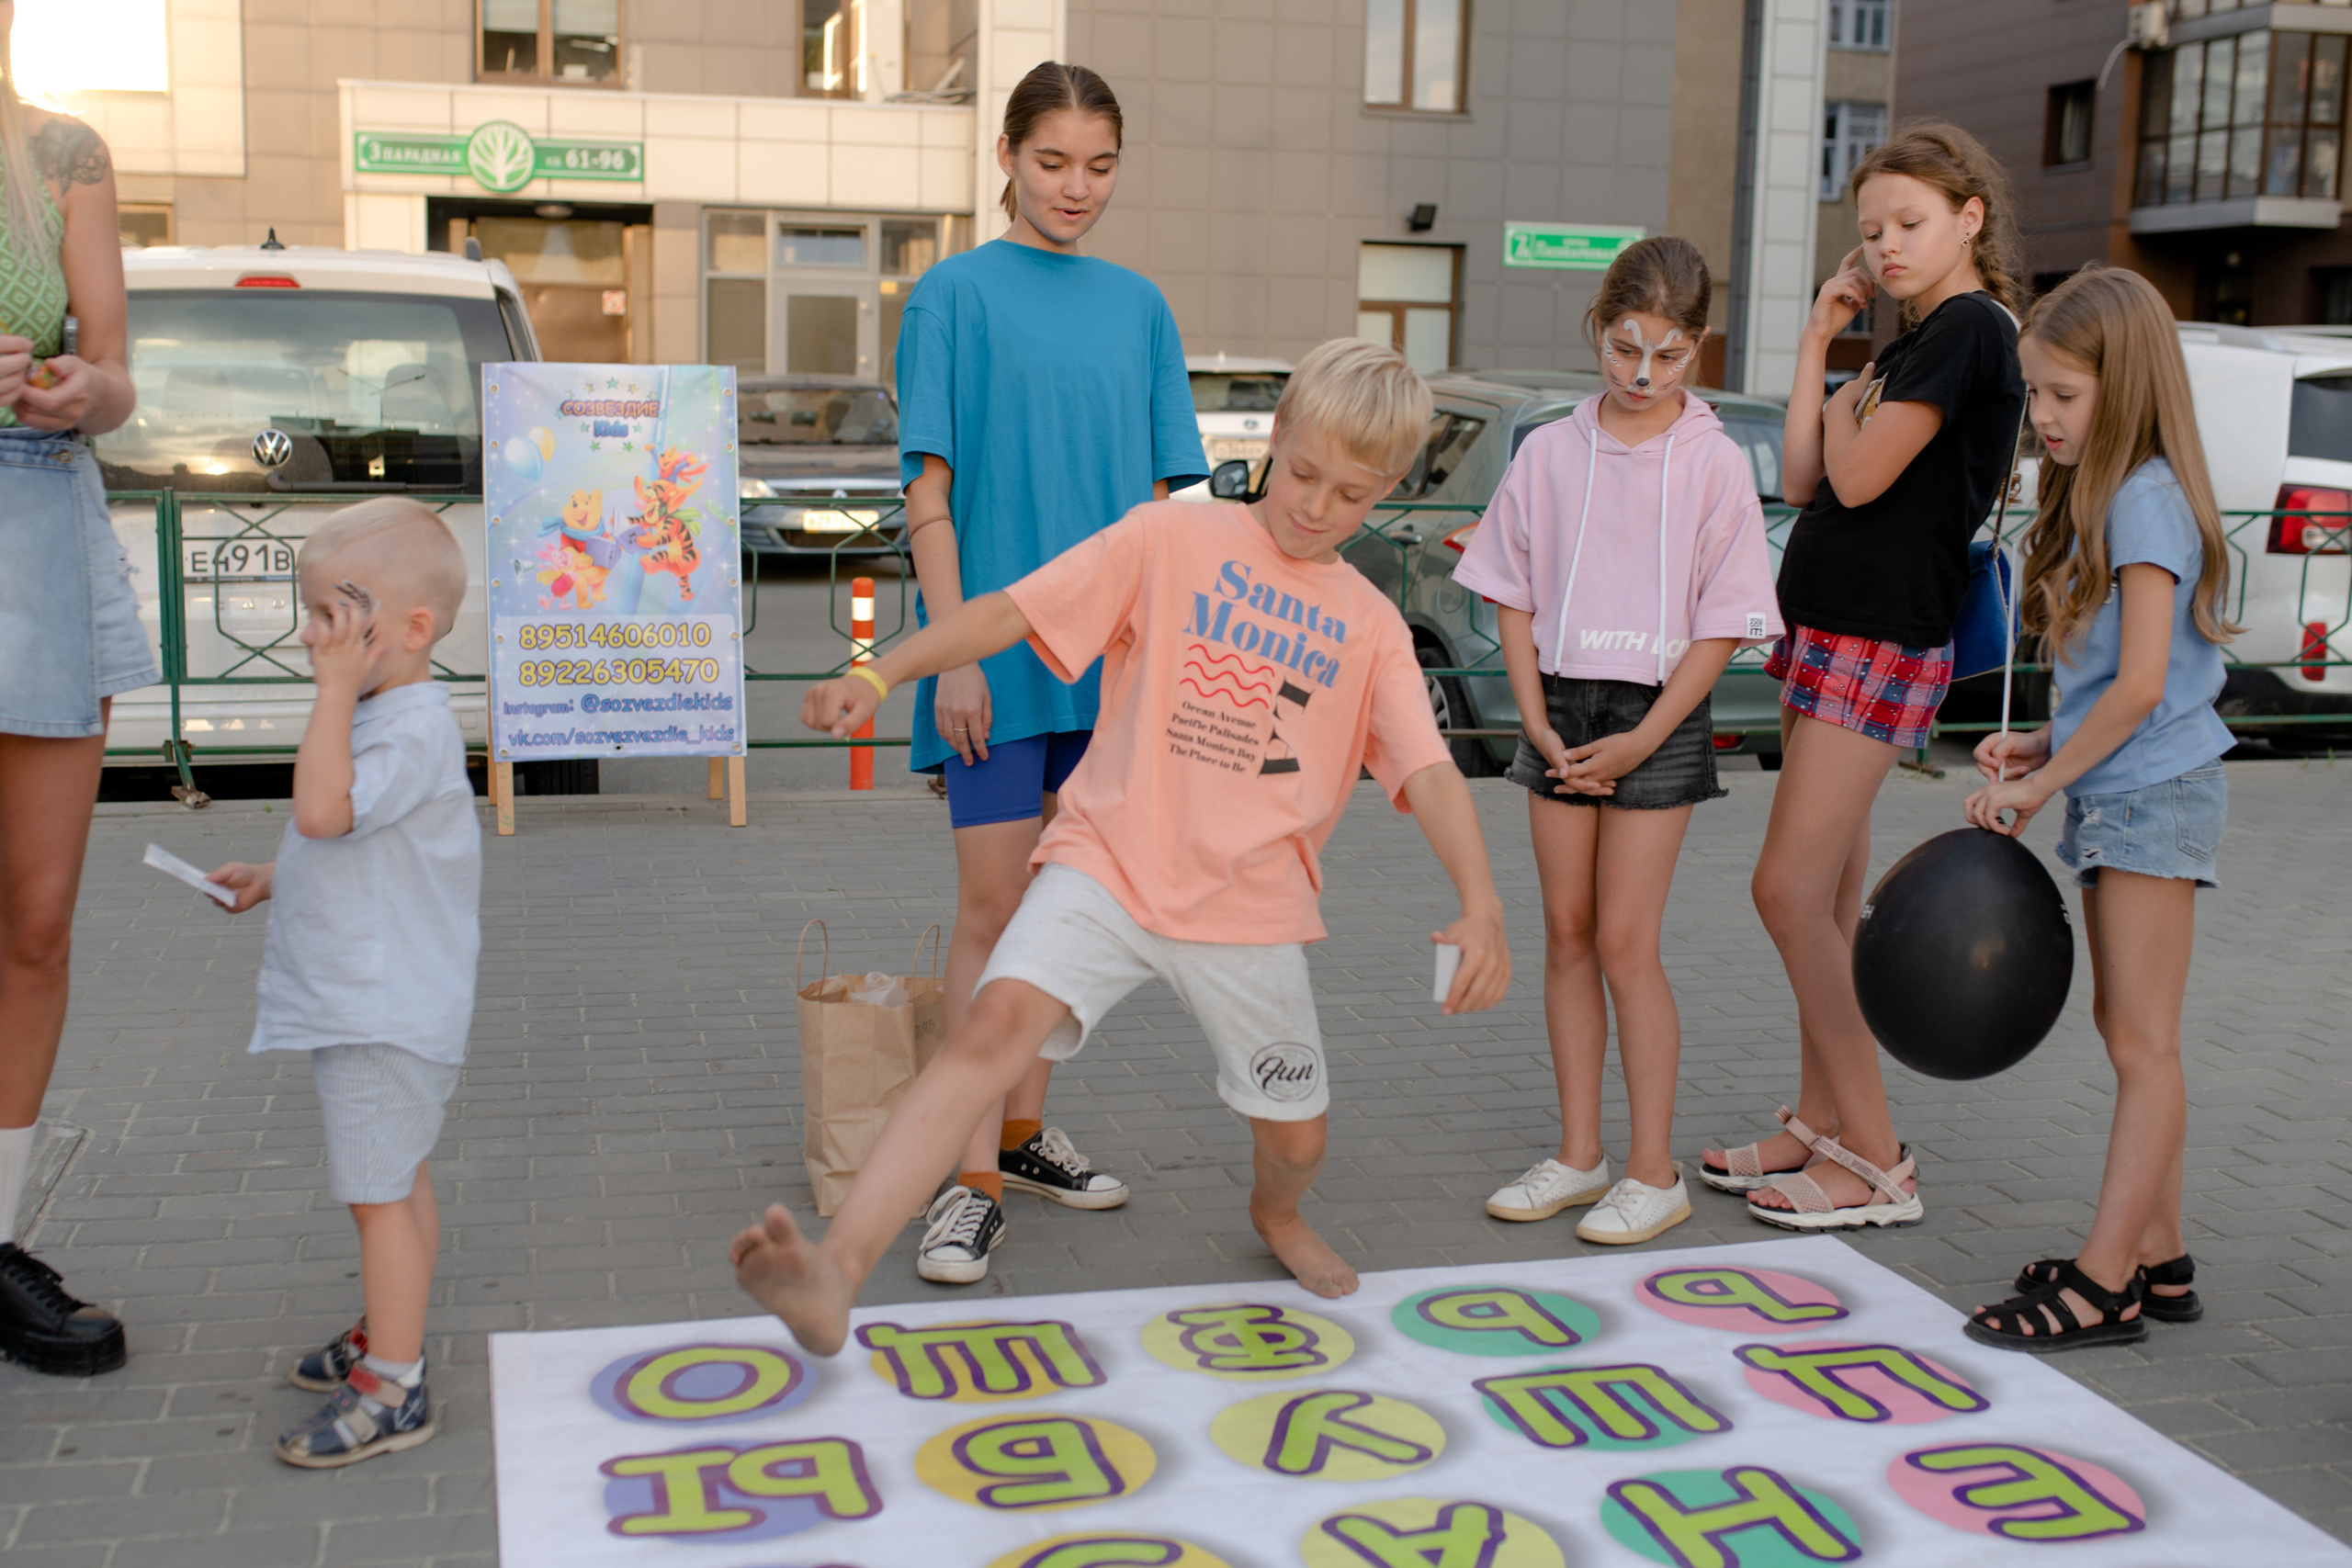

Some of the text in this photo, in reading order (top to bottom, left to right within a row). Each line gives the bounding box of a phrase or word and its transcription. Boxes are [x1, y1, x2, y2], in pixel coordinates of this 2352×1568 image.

[368, 141, 381, 162] 3
[383, 147, 460, 164] ПАРАДНАЯ
[565, 148, 626, 171] 61-96
[560, 400, 661, 419] СОЗВЕЗДИЕ
[594, 421, 628, 437] Kids
[1214, 560, 1348, 644] Santa
[519, 622, 711, 649] 89514606010
[1182, 591, 1340, 688] Monica
[1580, 629, 1691, 659] WITH LO
[519, 658, 718, 686] 89226305470
[581, 692, 733, 714] @sozvezdiekids
[1182, 700, 1257, 728] Ocean Avenue
[508, 724, 735, 747] vk.com/sozvezvezdie_kids
[1171, 713, 1260, 746] Pacific Palisades
[1166, 728, 1256, 763] Santa Monica Bay
[1170, 742, 1246, 773] The Place to Be
[1256, 1055, 1313, 1090] Fun
